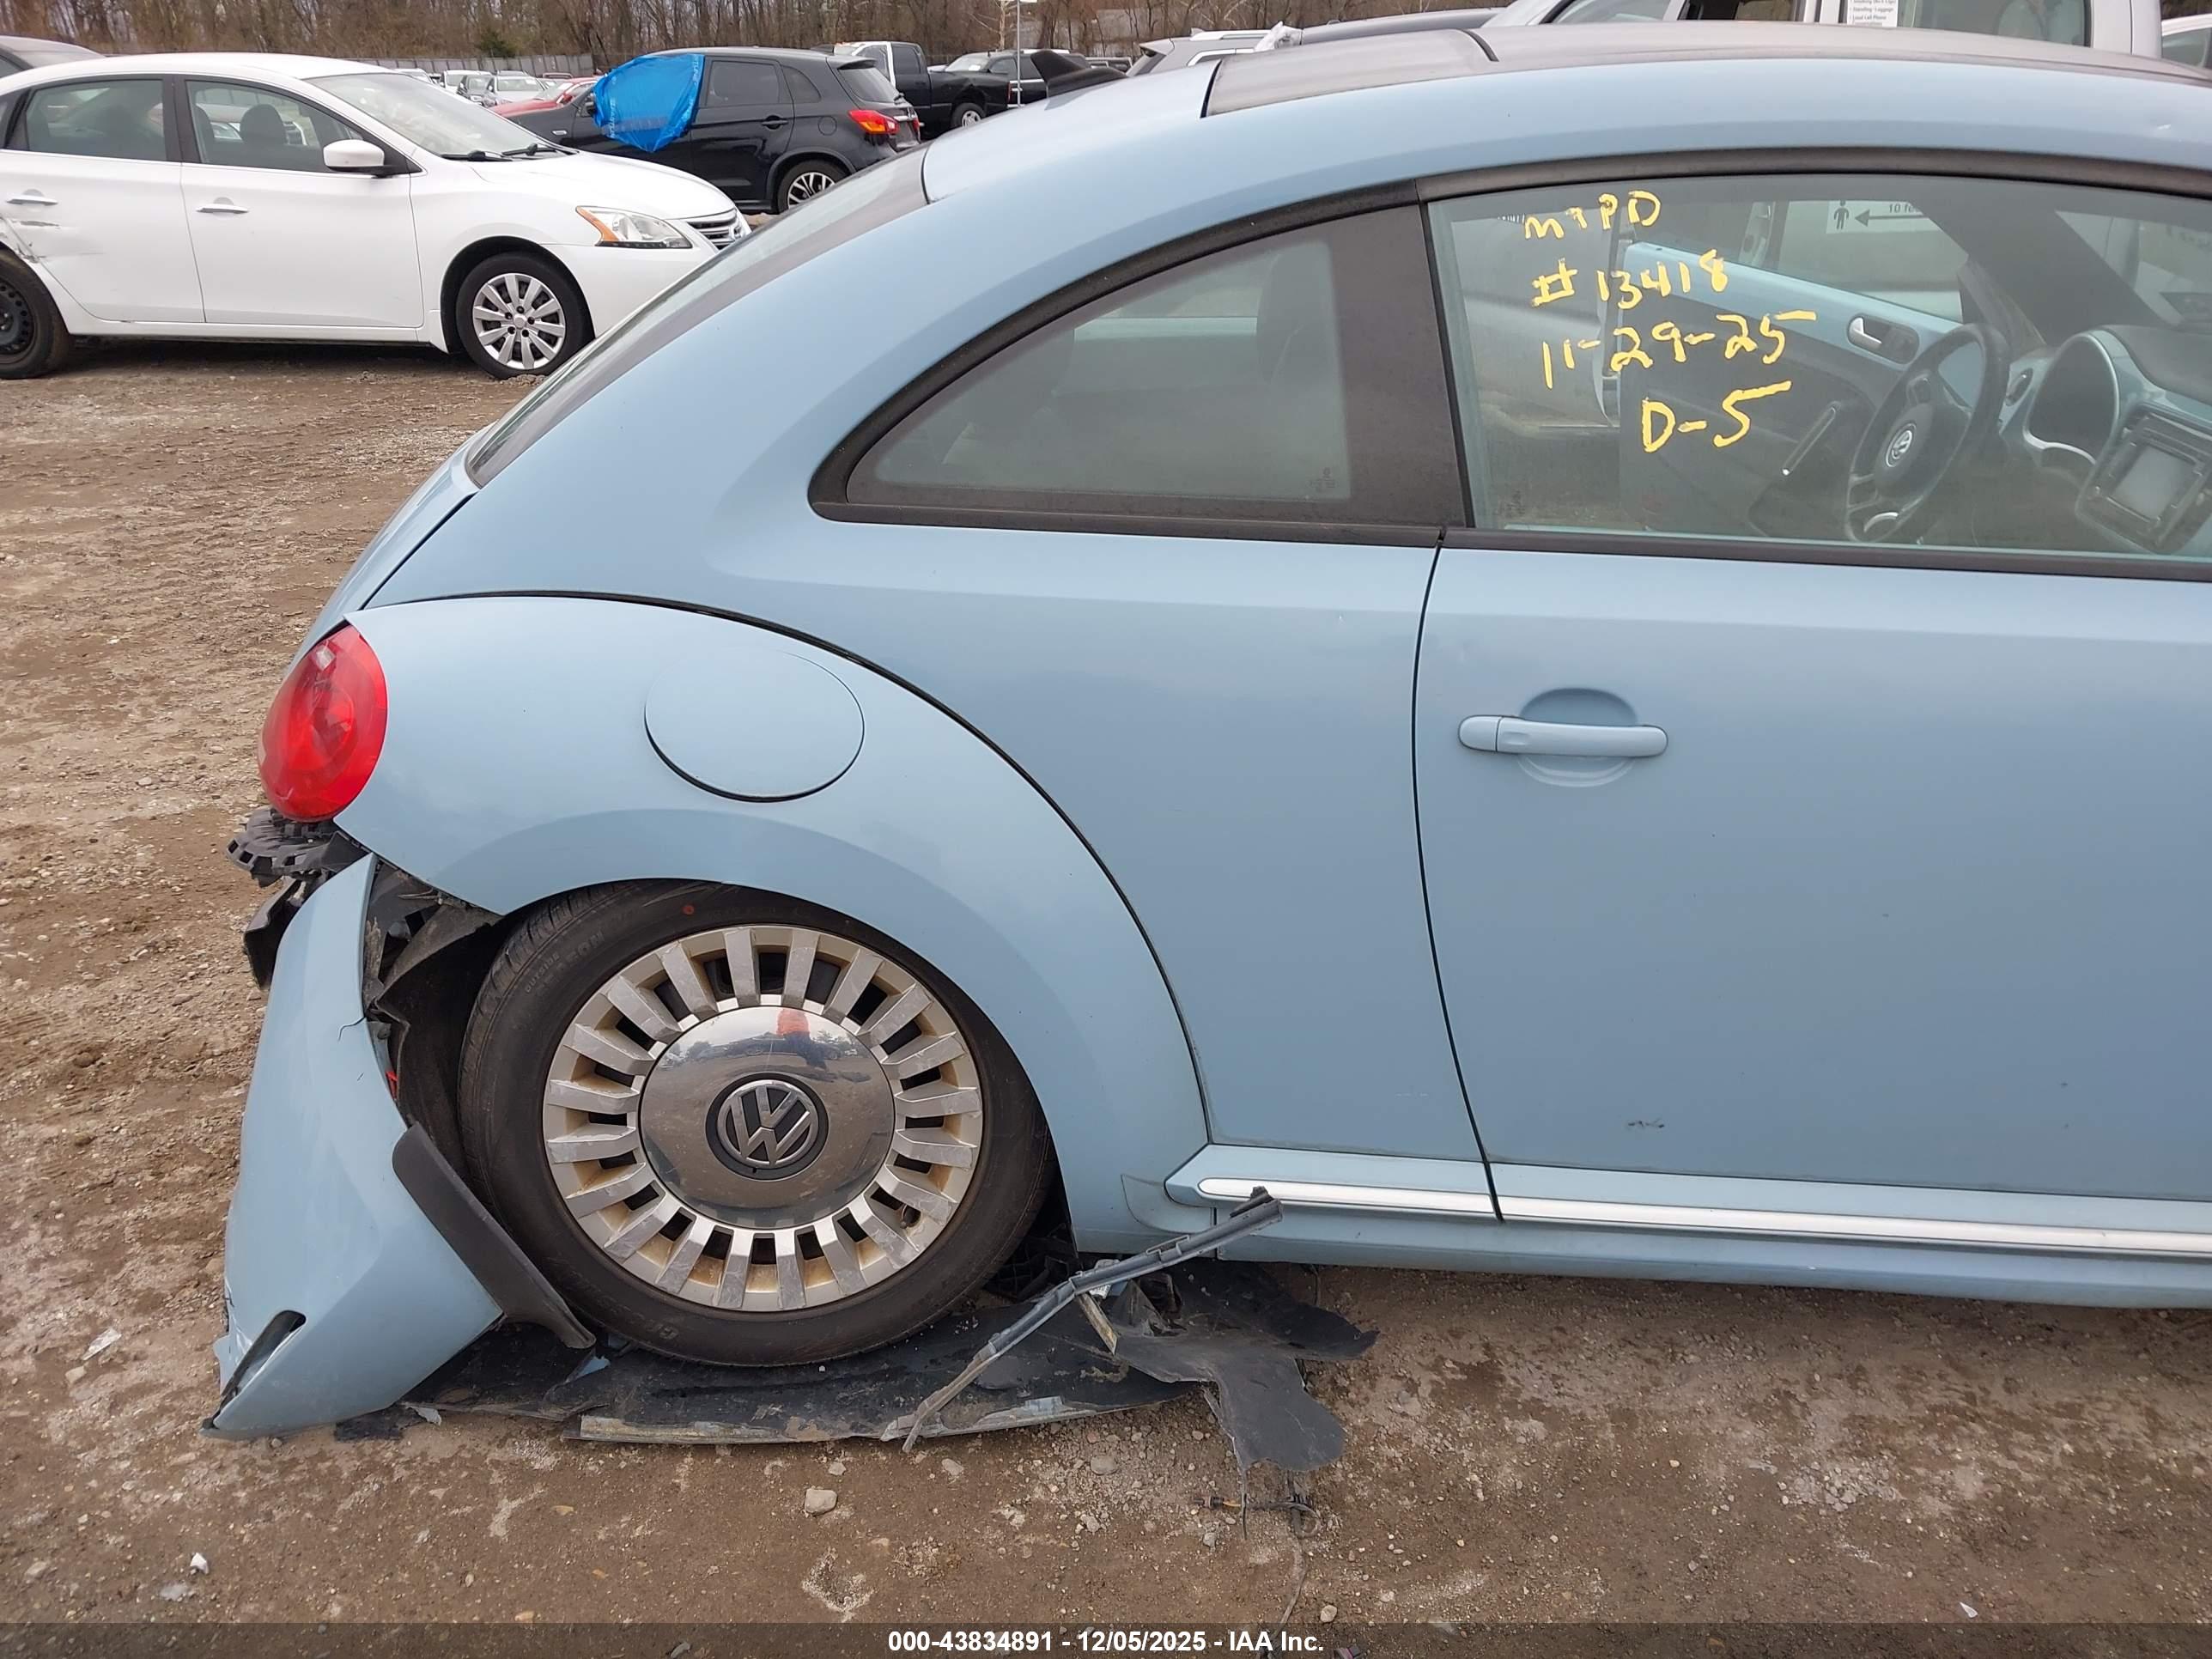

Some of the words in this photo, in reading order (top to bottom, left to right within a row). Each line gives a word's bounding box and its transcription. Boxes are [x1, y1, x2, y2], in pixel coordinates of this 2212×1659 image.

[1889, 204, 1901, 214] 10
[1541, 309, 1817, 389] 11-29-25
[1641, 380, 1792, 453] D-5
